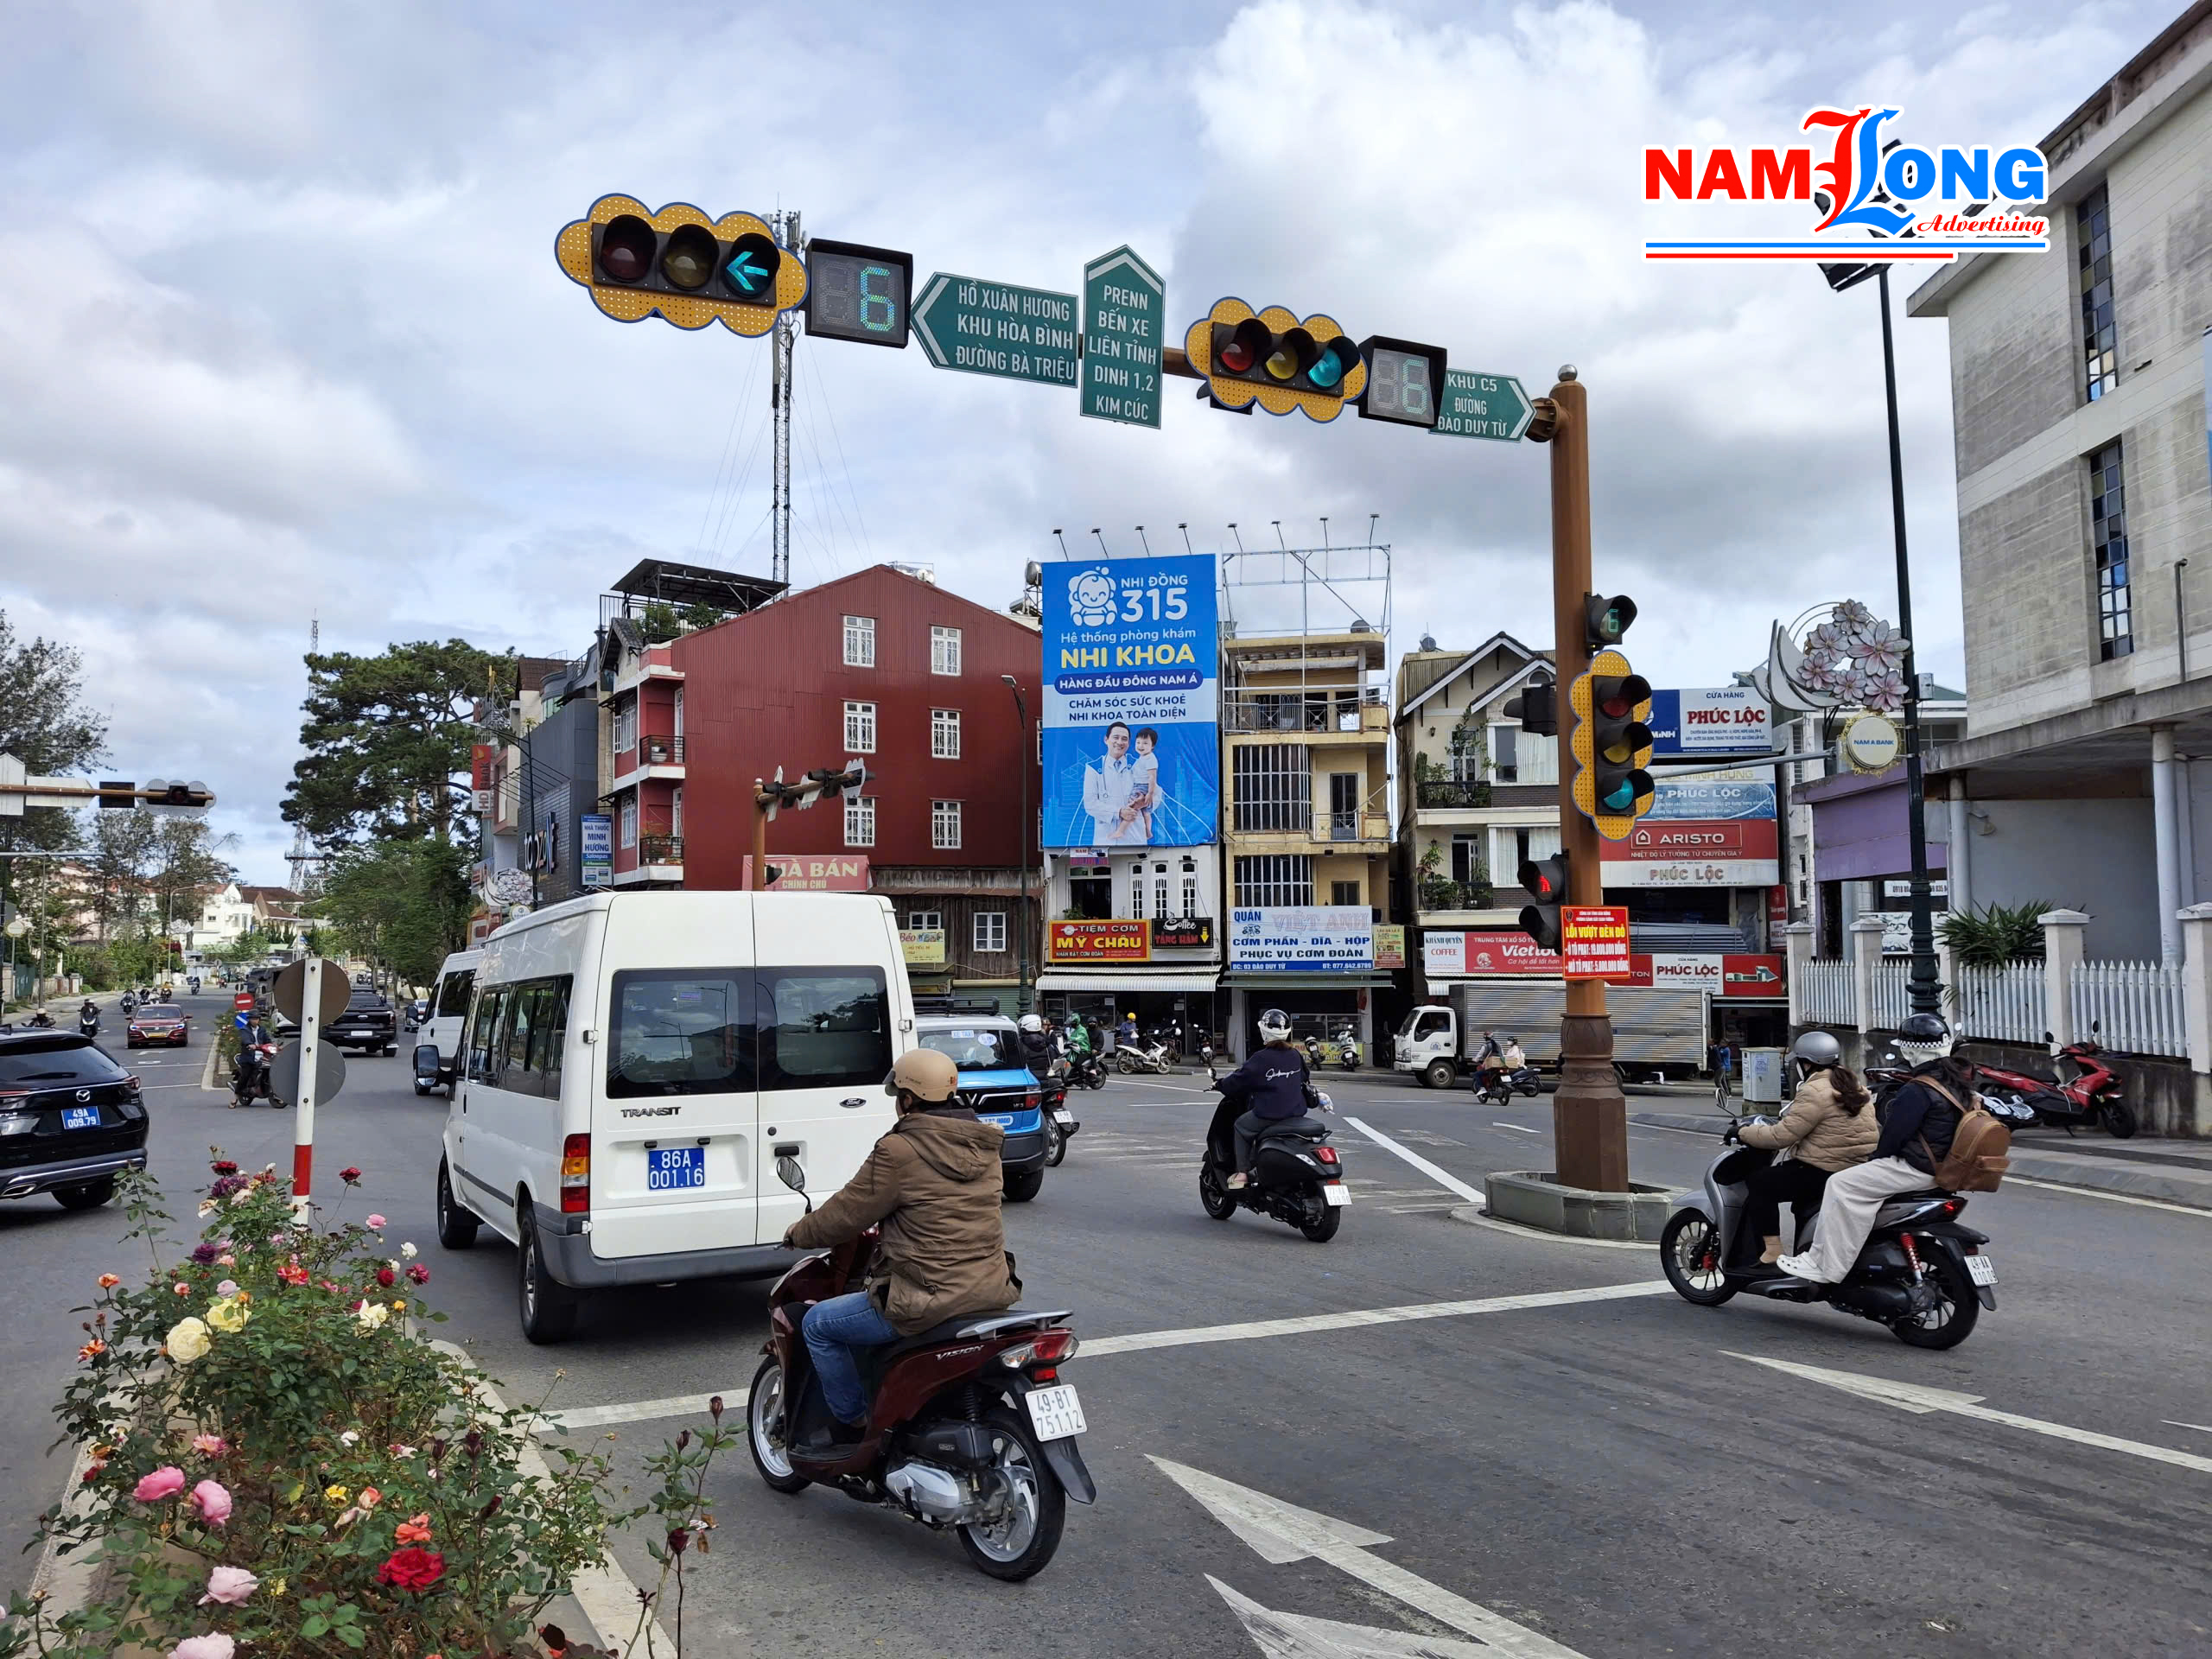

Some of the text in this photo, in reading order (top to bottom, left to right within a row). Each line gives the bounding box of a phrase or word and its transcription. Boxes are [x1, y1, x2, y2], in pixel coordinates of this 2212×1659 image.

[861, 265, 895, 332] 6
[958, 280, 1070, 321] HỒ XUÂN HƯƠNG
[1103, 284, 1148, 310] PRENN
[1098, 308, 1149, 337] BẾN XE
[957, 314, 1073, 350] KHU HÒA BÌNH
[1089, 335, 1157, 365] LIÊN TỈNH
[956, 346, 1075, 383] ĐƯỜNG BÀ TRIỆU
[1094, 365, 1128, 387] DINH
[1447, 374, 1498, 392] KHU C5
[1096, 395, 1148, 420] KIM CÚC
[1454, 393, 1487, 415] ĐƯỜNG
[1437, 411, 1510, 437] ĐÀO DUY TỪ
[1121, 572, 1188, 588] NHI ĐỒNG
[1121, 587, 1188, 623] 315
[1061, 627, 1196, 645] Hệ thống phòng khám
[1061, 643, 1196, 669] NHI KHOA
[1059, 671, 1198, 690] HÀNG ĐẦU ĐÔNG NAM Á
[1069, 697, 1101, 709] CHĂM
[1105, 696, 1127, 708] SÓC
[1130, 696, 1152, 706] SỨC
[1069, 706, 1186, 721] NHI KHOA TOÀN DIỆN
[1687, 706, 1765, 727] PHÚC LỘC
[1713, 787, 1741, 800] LỘC
[1660, 834, 1725, 844] ARISTO
[810, 858, 858, 878] BÁN
[1650, 865, 1724, 883] PHÚC LỘC
[782, 880, 807, 889] CHÍNH
[1078, 925, 1106, 933] TIỆM
[1163, 918, 1196, 931] Coffee
[1272, 910, 1320, 935] VIỆT
[1327, 912, 1369, 931] ANH
[1566, 923, 1578, 938] LỖI
[1579, 925, 1598, 940] VƯỢT
[1599, 925, 1614, 938] ĐÈN
[1057, 935, 1141, 948] MỸ CHÂU
[1345, 936, 1370, 947] HỘP
[1240, 950, 1273, 961] PHỤC
[1277, 950, 1293, 960] VỤ
[1329, 949, 1363, 957] ĐOÀN
[1657, 963, 1719, 977] PHÚC LỘC
[73, 1109, 88, 1118] 49A
[620, 1107, 681, 1118] TRANSIT
[67, 1117, 97, 1128] 009.79
[661, 1150, 691, 1168] 86A
[650, 1168, 703, 1188] 001.16
[936, 1344, 985, 1361] VISION
[1037, 1409, 1083, 1437] 751.12
